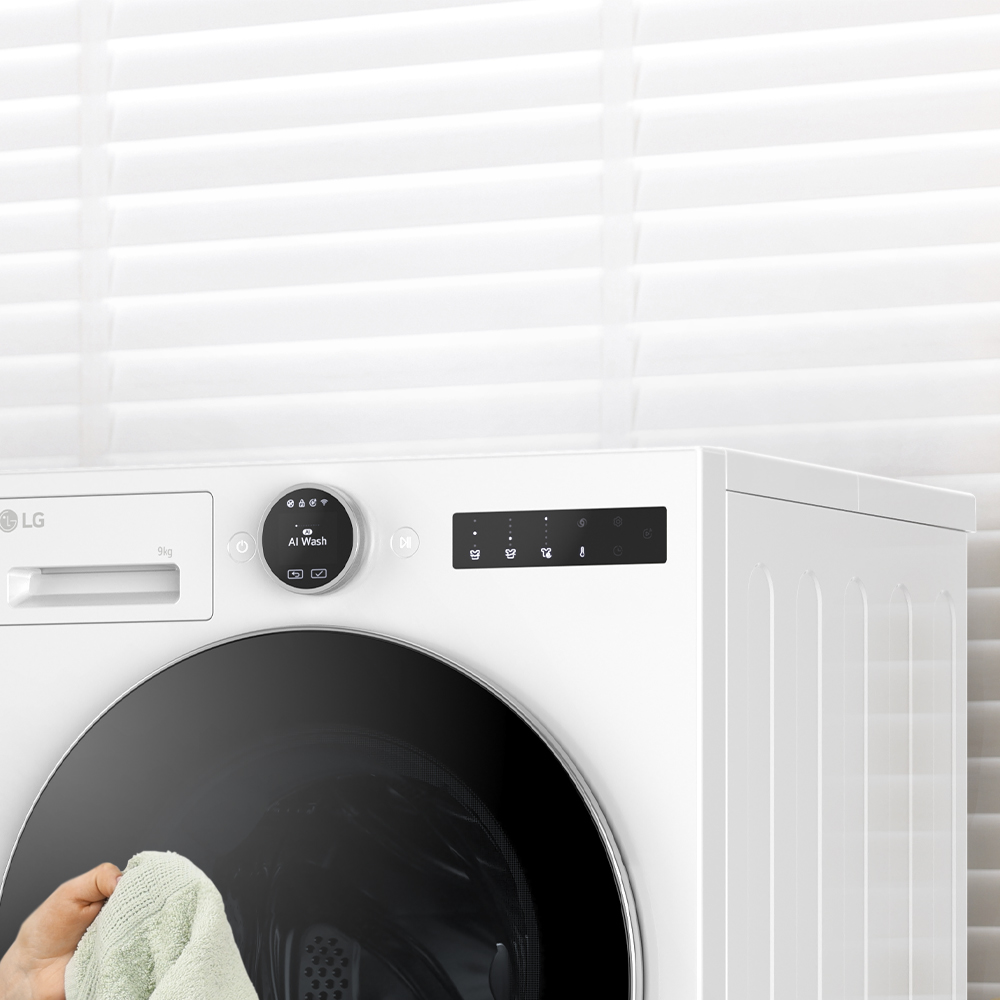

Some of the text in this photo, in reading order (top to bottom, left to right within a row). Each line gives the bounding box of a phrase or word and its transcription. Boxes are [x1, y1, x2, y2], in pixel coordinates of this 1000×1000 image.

[22, 511, 45, 529] LG
[288, 536, 327, 547] AI Wash
[157, 546, 173, 559] 9kg
